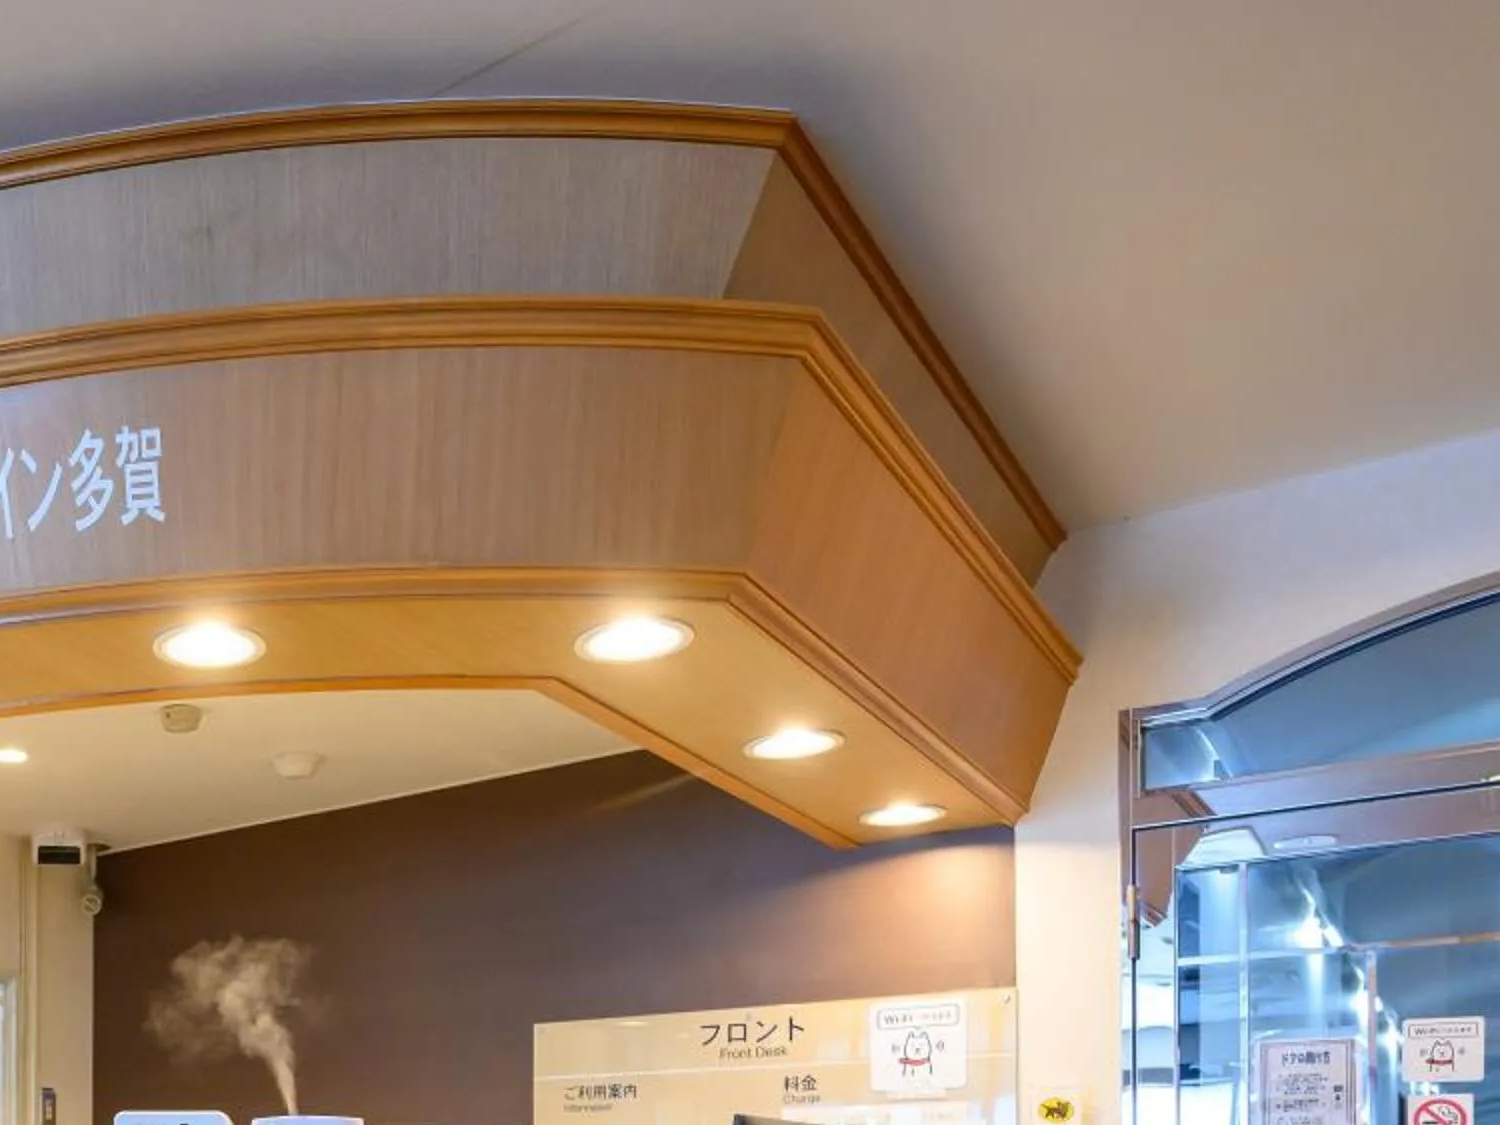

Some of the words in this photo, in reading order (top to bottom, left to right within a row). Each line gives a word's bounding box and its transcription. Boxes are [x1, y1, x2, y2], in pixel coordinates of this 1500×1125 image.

[701, 1016, 805, 1045] フロント
[719, 1047, 752, 1061] Front
[755, 1046, 788, 1059] Desk
[564, 1083, 638, 1100] ご利用案内
[784, 1074, 817, 1092] 料金
